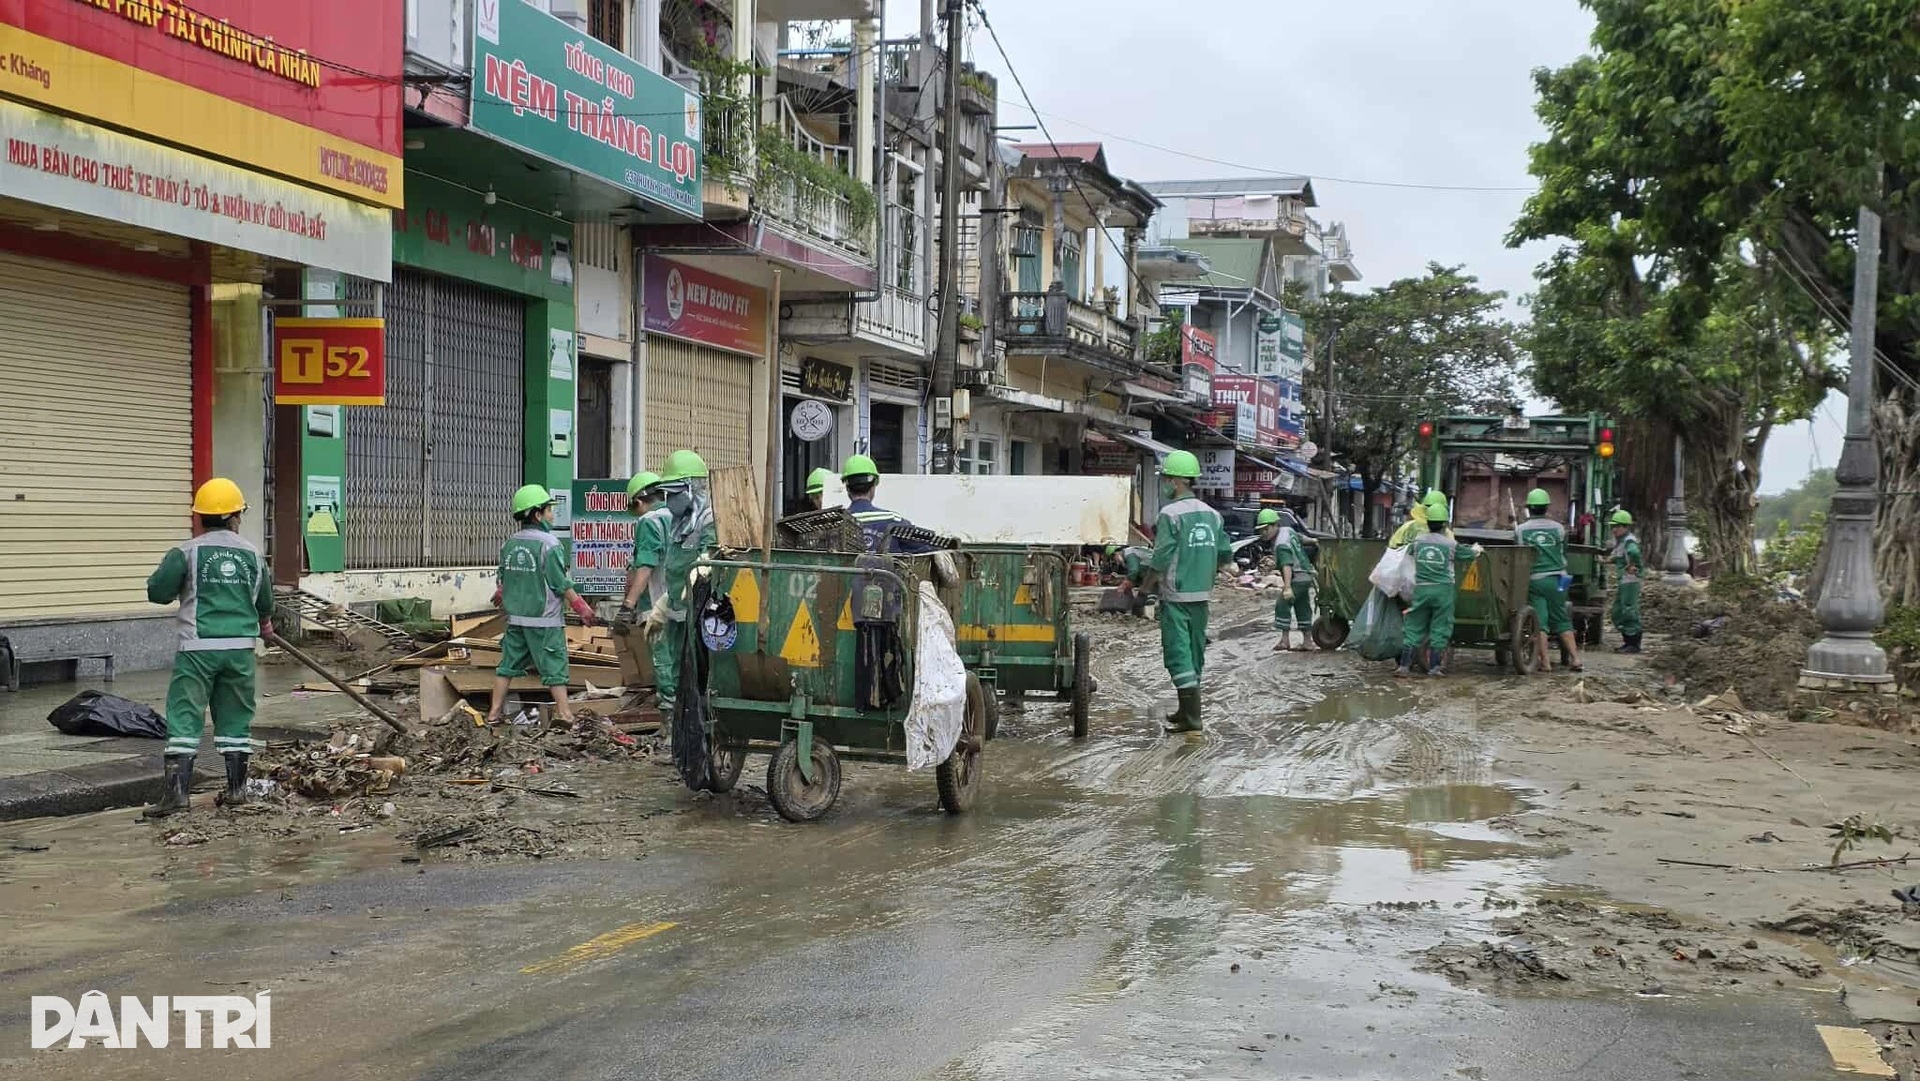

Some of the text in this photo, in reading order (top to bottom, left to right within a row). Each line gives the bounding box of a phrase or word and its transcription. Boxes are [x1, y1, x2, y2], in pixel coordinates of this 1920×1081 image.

[201, 18, 252, 63] CHÍNH
[253, 35, 276, 72] CÁ
[279, 49, 320, 87] NHÂN
[564, 41, 635, 99] TỔNG KHO
[10, 53, 50, 89] Kháng
[484, 52, 697, 183] NỆM THẮNG LỢI
[8, 138, 327, 241] MUA BÁN CHO THUÊ XE MÁY Ô TÔ & NHẬN KÝ GỬI NHÀ ĐẤT
[686, 281, 750, 317] NEW BODY FIT
[291, 346, 371, 377] T 52
[585, 484, 629, 512] TỔNG KHO
[573, 518, 594, 545] NỆM
[595, 515, 626, 541] THẮNG
[576, 550, 596, 569] MUA
[789, 572, 818, 599] 02
